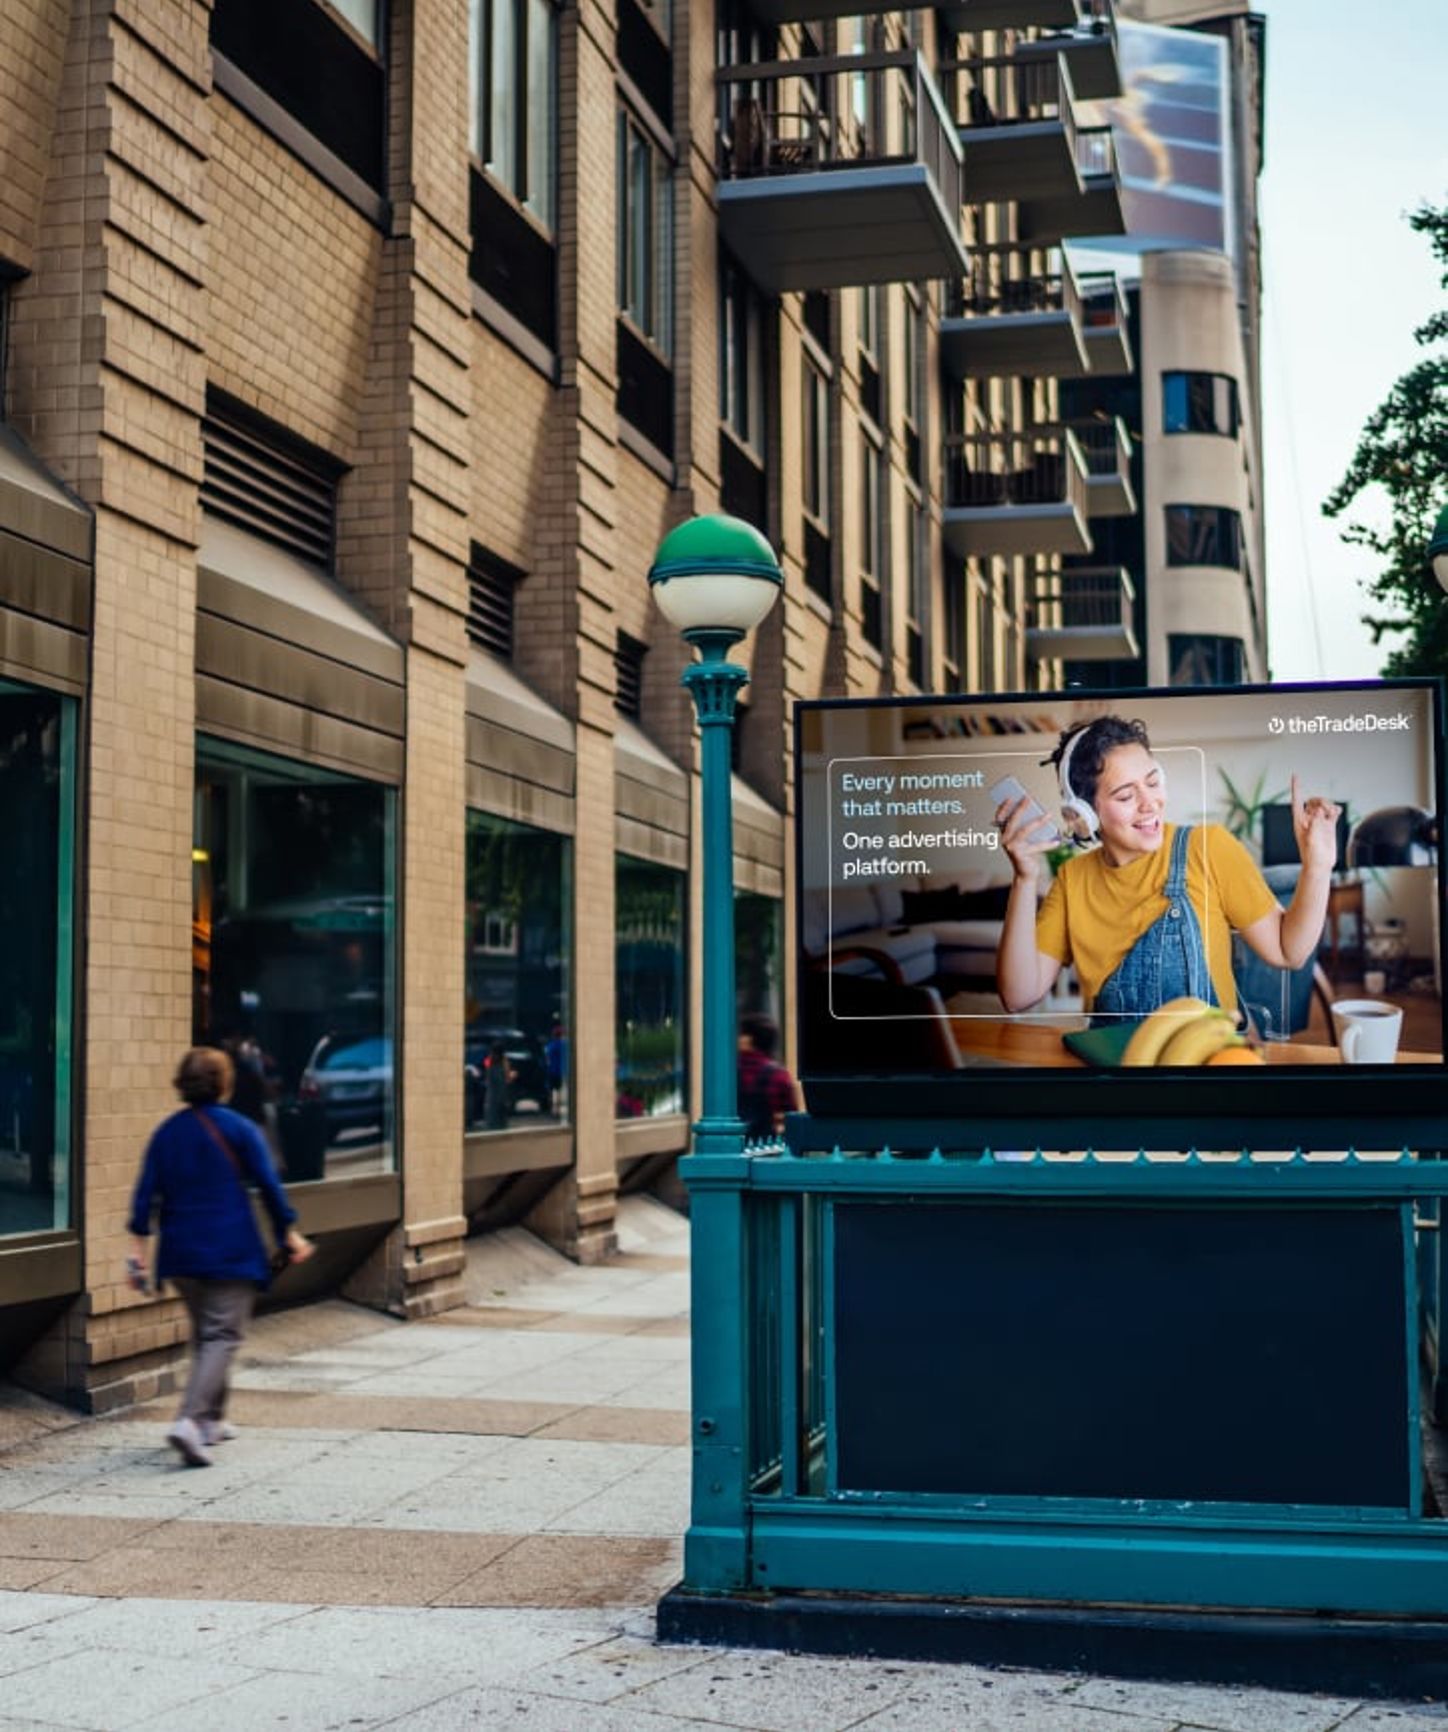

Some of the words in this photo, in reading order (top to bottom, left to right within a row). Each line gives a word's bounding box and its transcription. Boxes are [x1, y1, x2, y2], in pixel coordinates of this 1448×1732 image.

[842, 774, 895, 794] Every
[900, 771, 984, 790] moment
[842, 799, 882, 816] that
[886, 798, 966, 816] matters.
[842, 832, 884, 850] One
[888, 828, 999, 850] advertising
[842, 857, 931, 880] platform.
